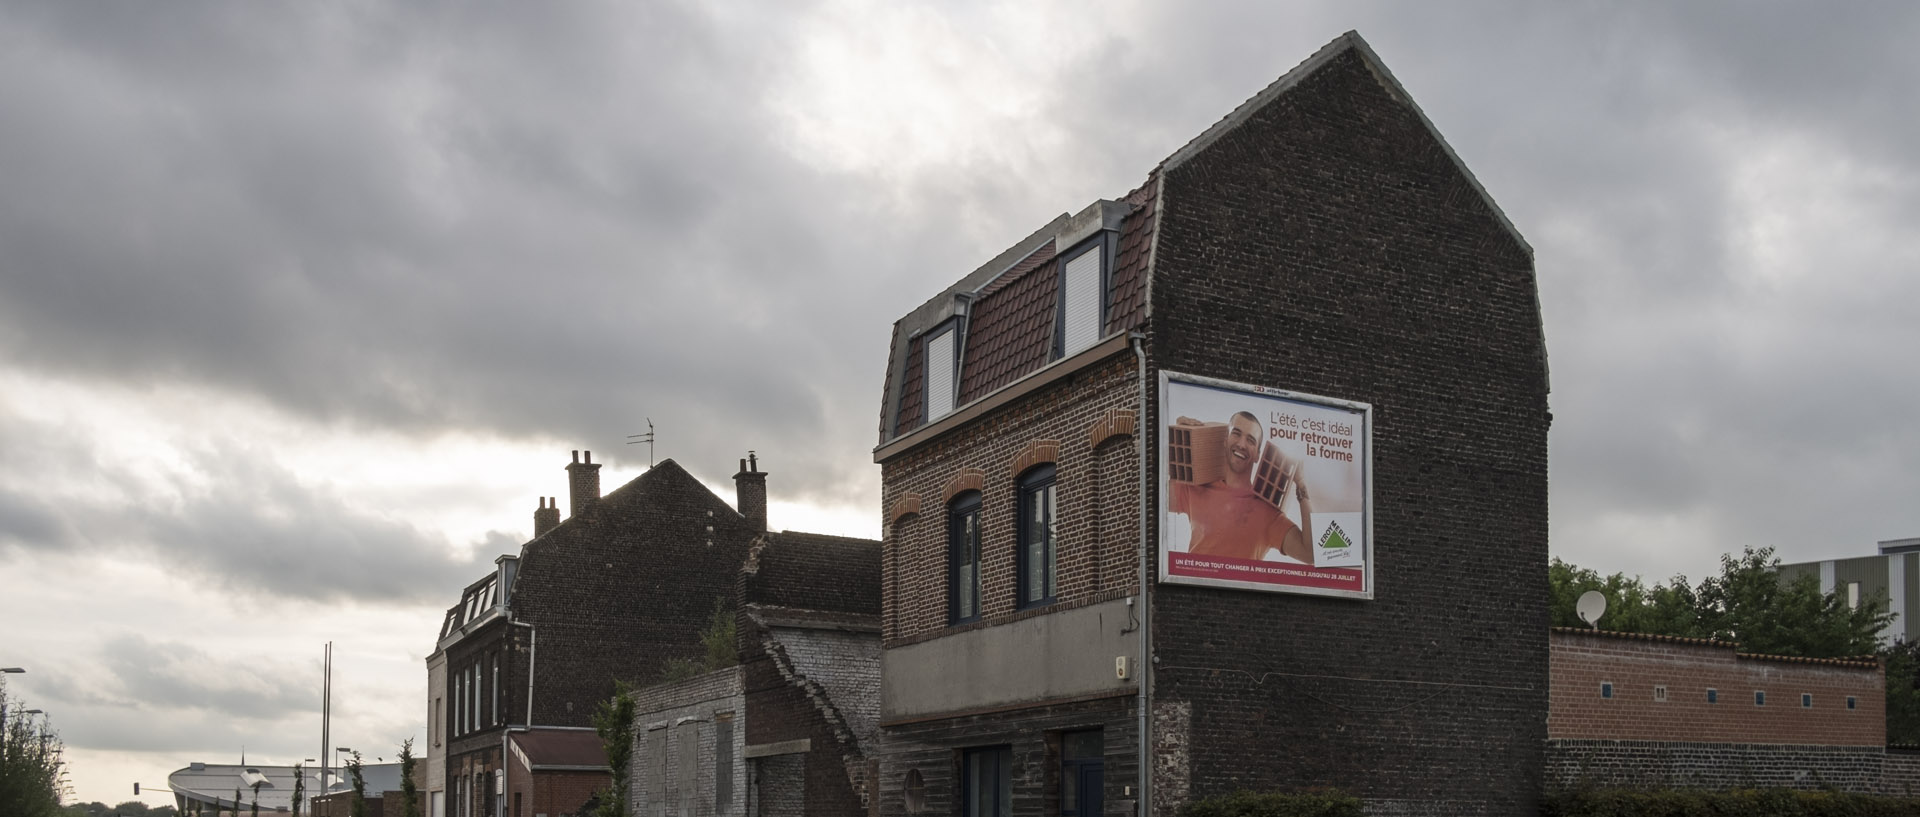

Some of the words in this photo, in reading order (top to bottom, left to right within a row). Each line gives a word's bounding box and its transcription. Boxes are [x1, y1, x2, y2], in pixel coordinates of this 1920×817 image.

[1270, 411, 1299, 430] L'été,
[1301, 417, 1326, 433] c'est
[1328, 420, 1353, 437] idéal
[1270, 427, 1297, 440] pour
[1300, 432, 1353, 449] retrouver
[1306, 443, 1317, 457] la
[1319, 445, 1353, 462] forme
[1318, 525, 1333, 547] LEROY
[1330, 520, 1352, 546] MERLIN
[1224, 563, 1250, 572] CHANGER
[1268, 568, 1307, 577] EXCEPTIONNELS
